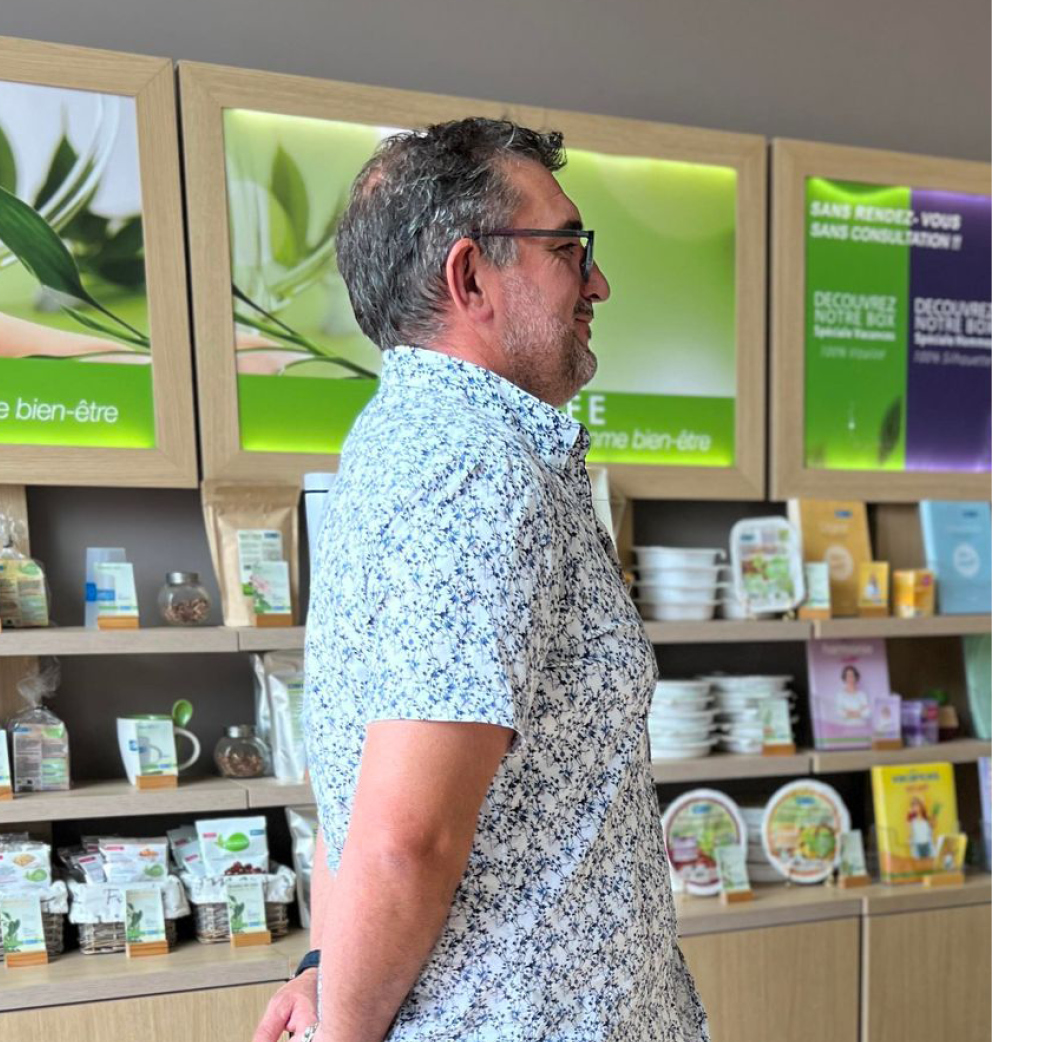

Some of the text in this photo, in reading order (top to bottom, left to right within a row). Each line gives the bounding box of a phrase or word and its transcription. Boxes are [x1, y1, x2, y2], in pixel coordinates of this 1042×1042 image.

[810, 201, 853, 218] SANS
[921, 211, 962, 230] VOUS
[810, 221, 848, 240] SANS
[851, 225, 949, 249] CONSULTATION
[15, 397, 119, 424] bien-être
